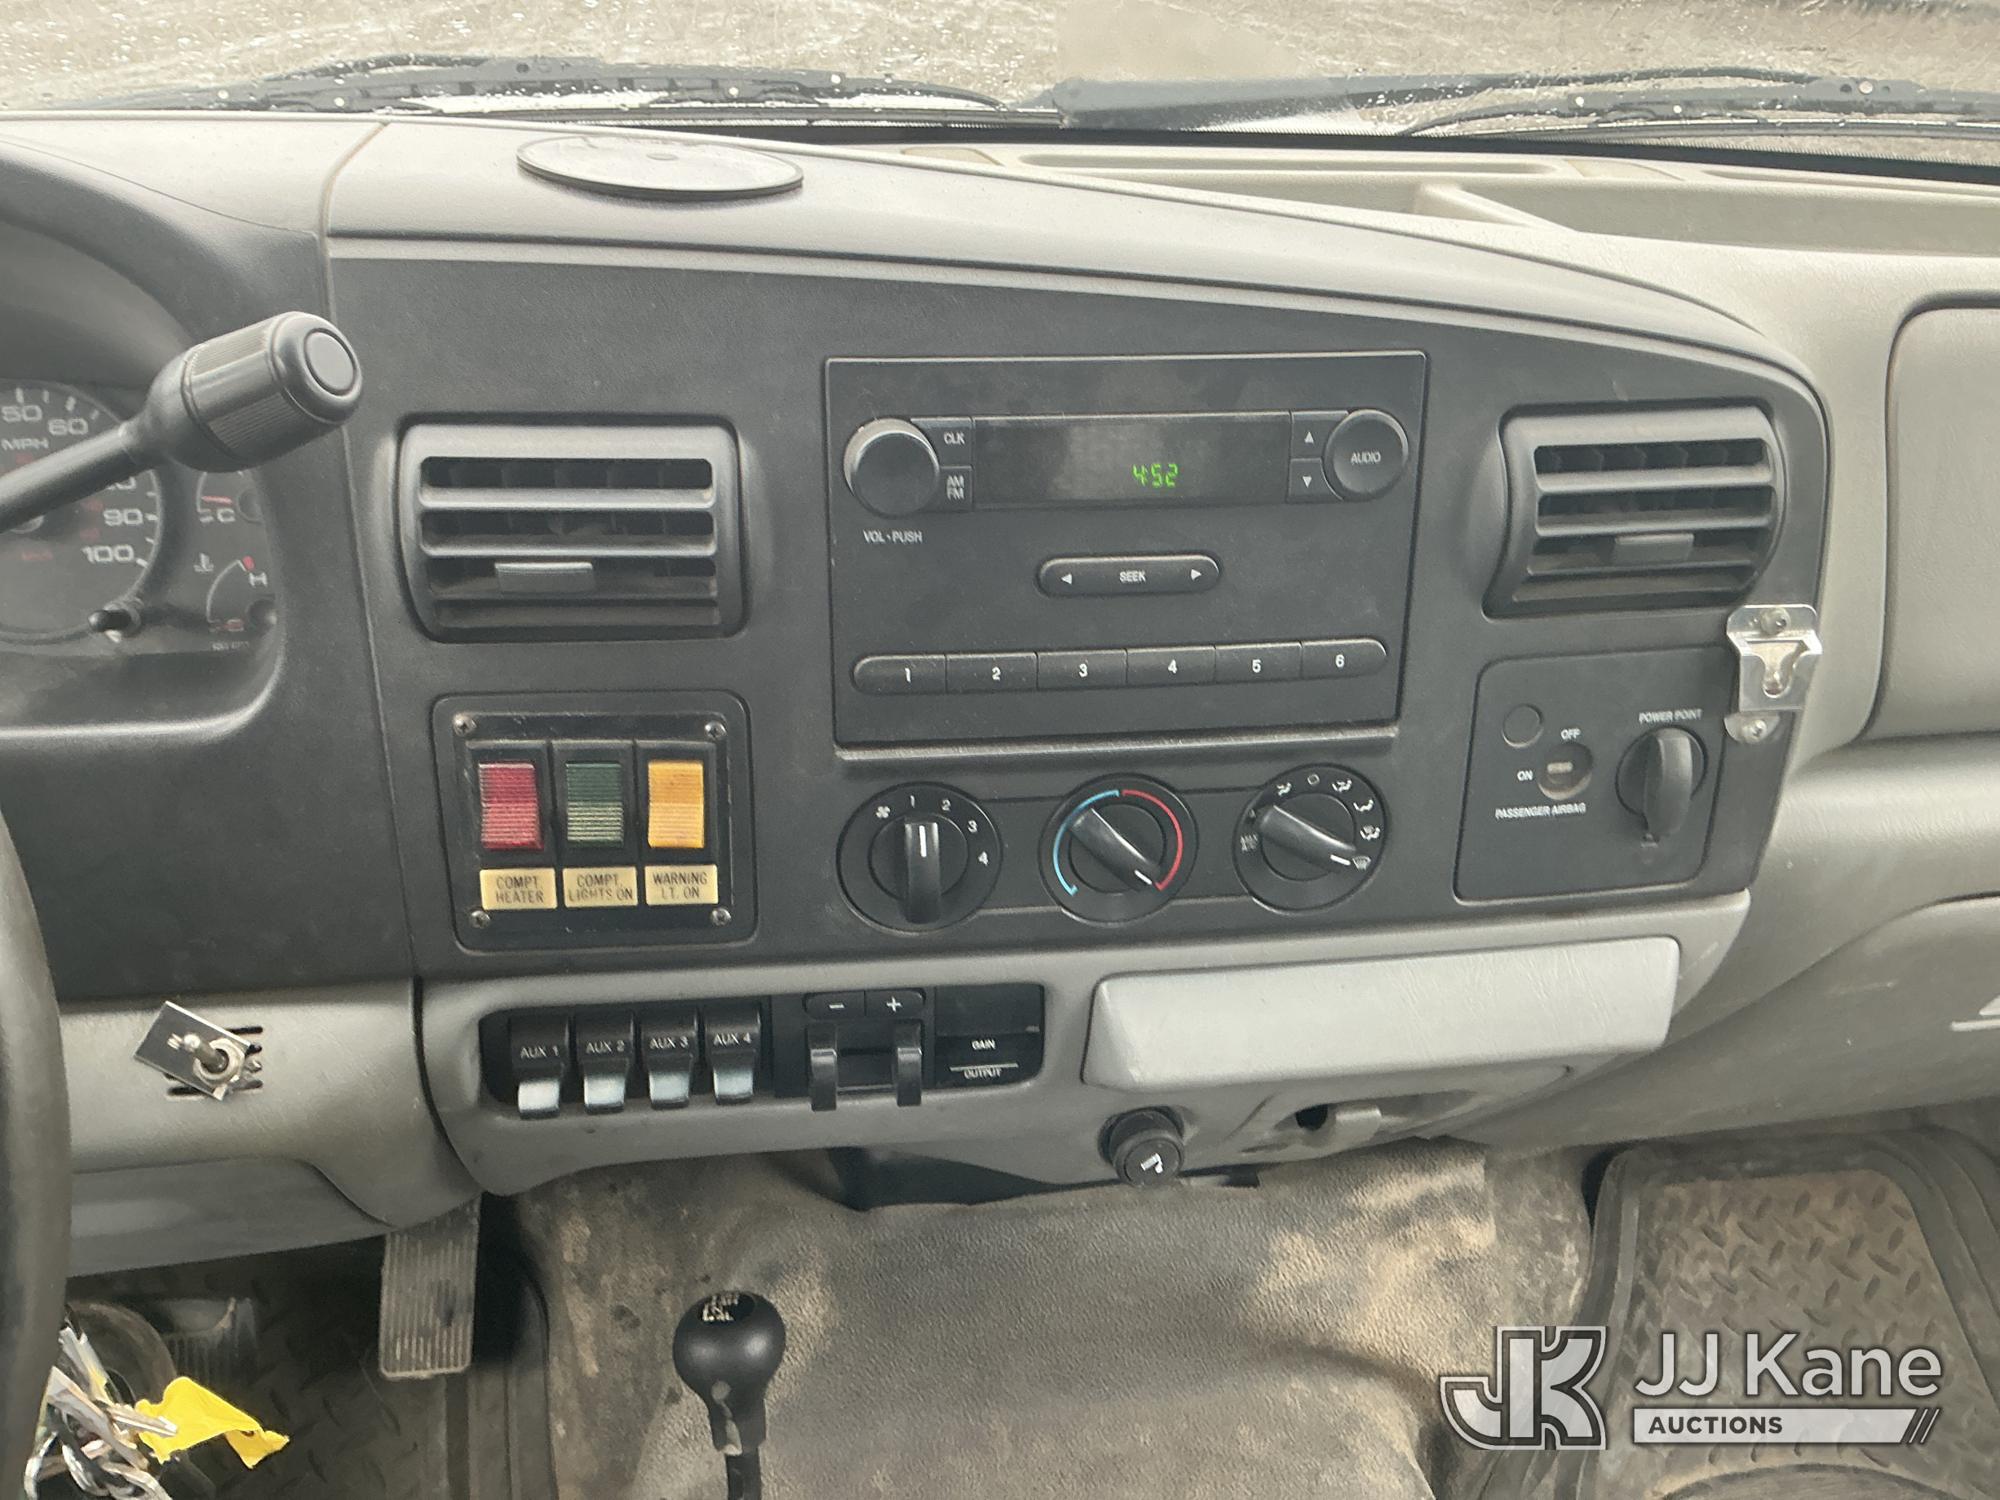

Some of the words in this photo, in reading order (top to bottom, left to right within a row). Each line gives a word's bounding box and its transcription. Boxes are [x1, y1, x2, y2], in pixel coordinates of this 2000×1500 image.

[1, 404, 43, 422] 50
[48, 418, 89, 435] 60
[1, 437, 49, 450] MPH
[943, 431, 966, 445] CLK
[1350, 452, 1382, 465] AUDIO
[103, 508, 143, 526] 90
[862, 529, 886, 543] VOL
[891, 529, 923, 543] PUSH
[81, 544, 135, 564] 100
[1119, 570, 1147, 584] SEEK
[1167, 659, 1178, 674] 4
[1251, 658, 1262, 673] 5
[1334, 654, 1345, 668] 6
[904, 667, 912, 683] 1
[991, 666, 1001, 681] 2
[1078, 661, 1088, 678] 3
[1639, 710, 1673, 724] POWER
[1674, 708, 1702, 721] POINT
[1560, 727, 1581, 741] OFF
[1516, 769, 1534, 781] ON
[909, 795, 916, 809] 1
[940, 799, 951, 812] 2
[1495, 805, 1551, 820] PASSENGER
[1551, 801, 1587, 817] AIRBAG
[967, 820, 978, 834] 3
[977, 851, 989, 867] 4
[652, 871, 708, 886] WARNING
[495, 890, 545, 904] HEATER
[568, 888, 612, 902] LIGHTS
[616, 887, 633, 901] ON
[683, 885, 700, 900] ON
[649, 1036, 676, 1050] AUX
[679, 1035, 690, 1049] 3
[712, 1032, 738, 1046] AUX
[742, 1031, 752, 1044] 4
[971, 1038, 996, 1051] GAIN
[520, 1046, 546, 1060] AUX
[551, 1044, 560, 1057] 1
[585, 1041, 611, 1055] AUX
[615, 1040, 626, 1053] 2
[963, 1067, 1002, 1080] OUTPUT
